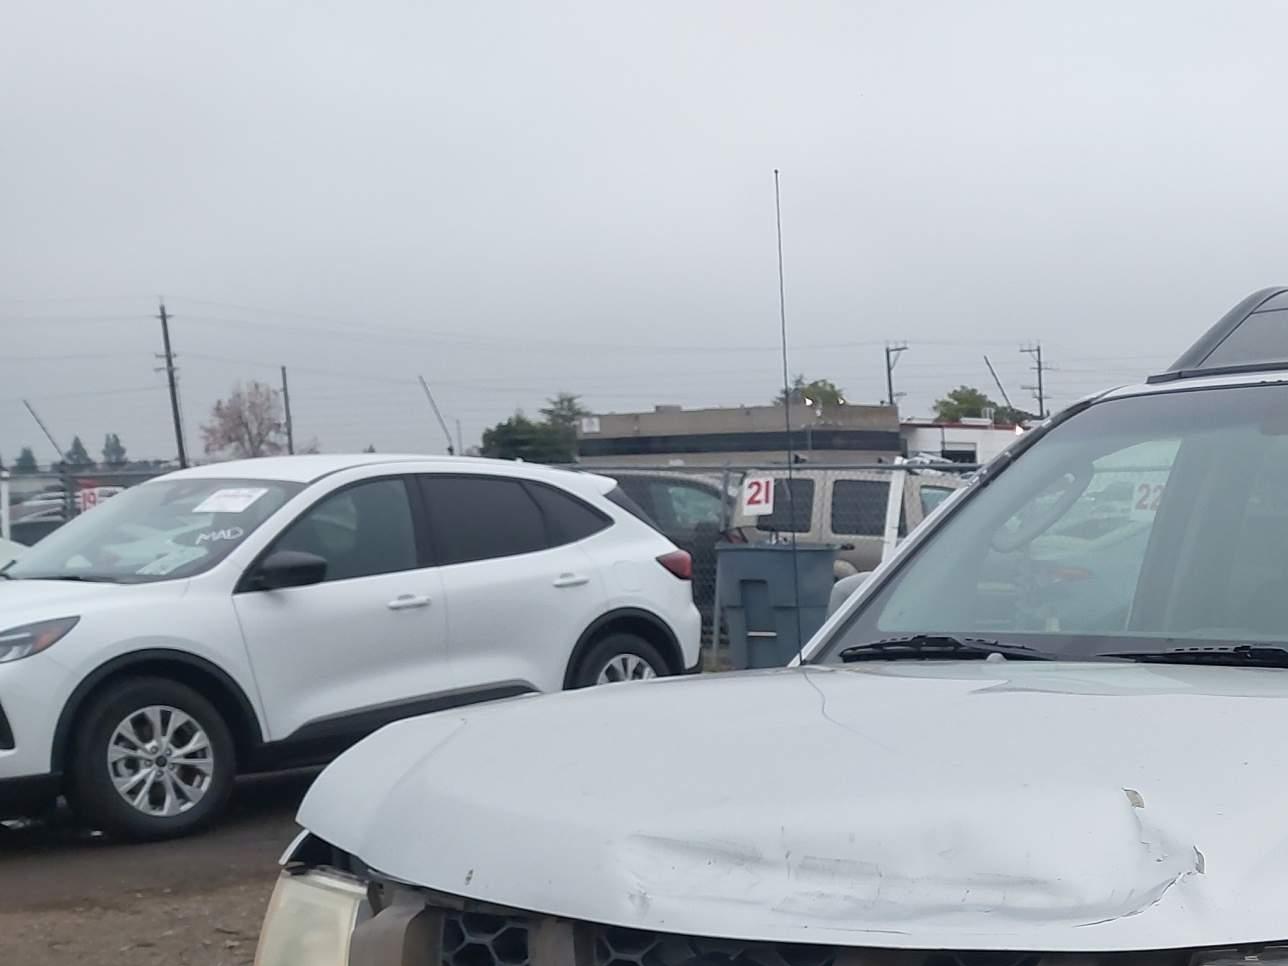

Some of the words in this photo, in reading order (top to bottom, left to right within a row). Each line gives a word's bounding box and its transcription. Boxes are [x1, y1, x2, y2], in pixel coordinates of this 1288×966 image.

[746, 480, 771, 506] 21
[1135, 483, 1167, 511] 22
[195, 526, 244, 545] MAD
